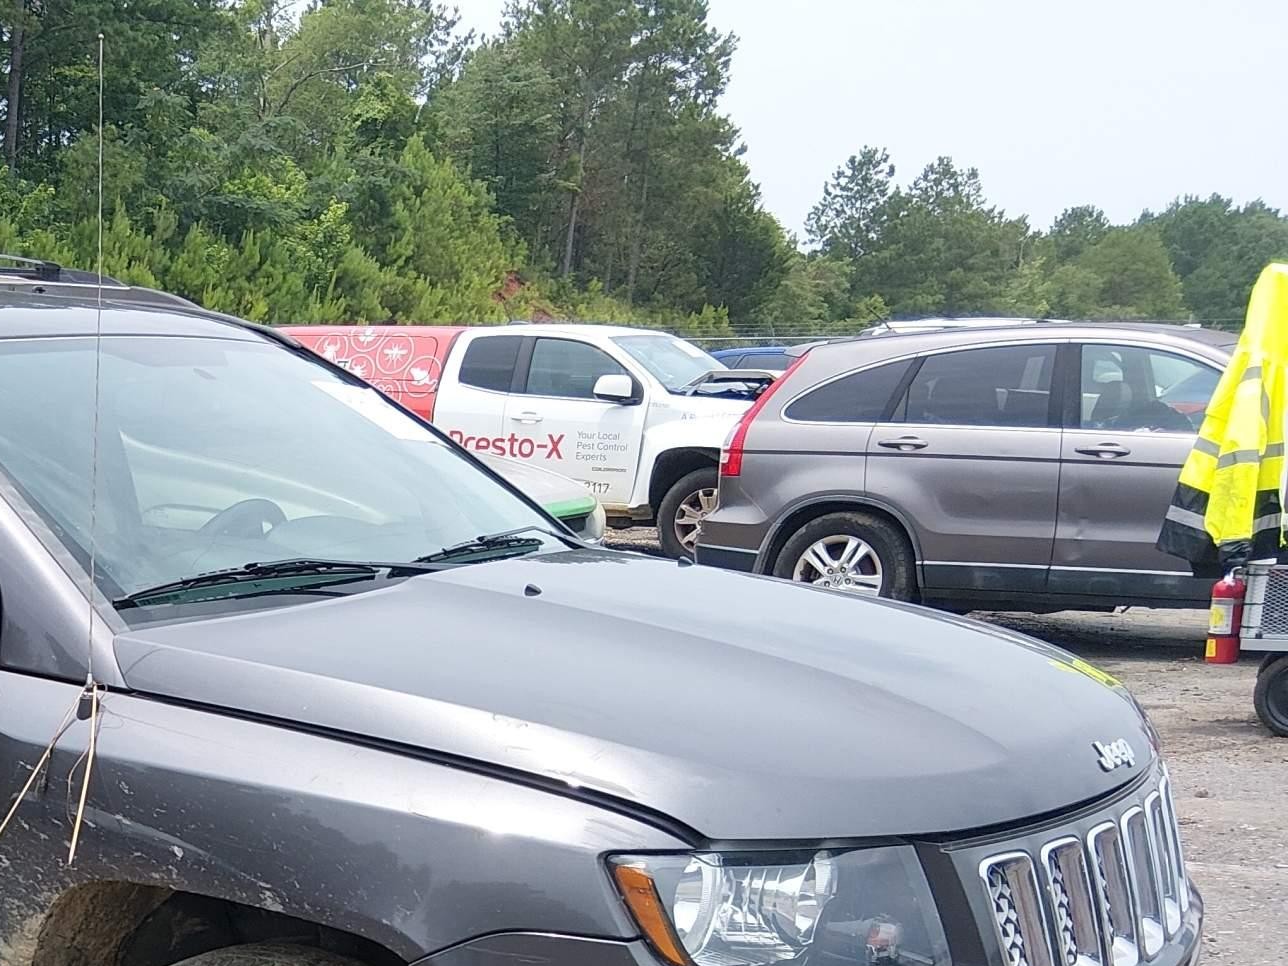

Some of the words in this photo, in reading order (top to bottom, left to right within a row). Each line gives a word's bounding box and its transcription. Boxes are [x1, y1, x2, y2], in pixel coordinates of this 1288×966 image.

[577, 430, 597, 440] Your
[598, 431, 620, 440] Local
[576, 441, 595, 450] Pest
[597, 442, 628, 452] Control
[576, 451, 607, 462] Experts
[1092, 738, 1135, 770] Jeep
